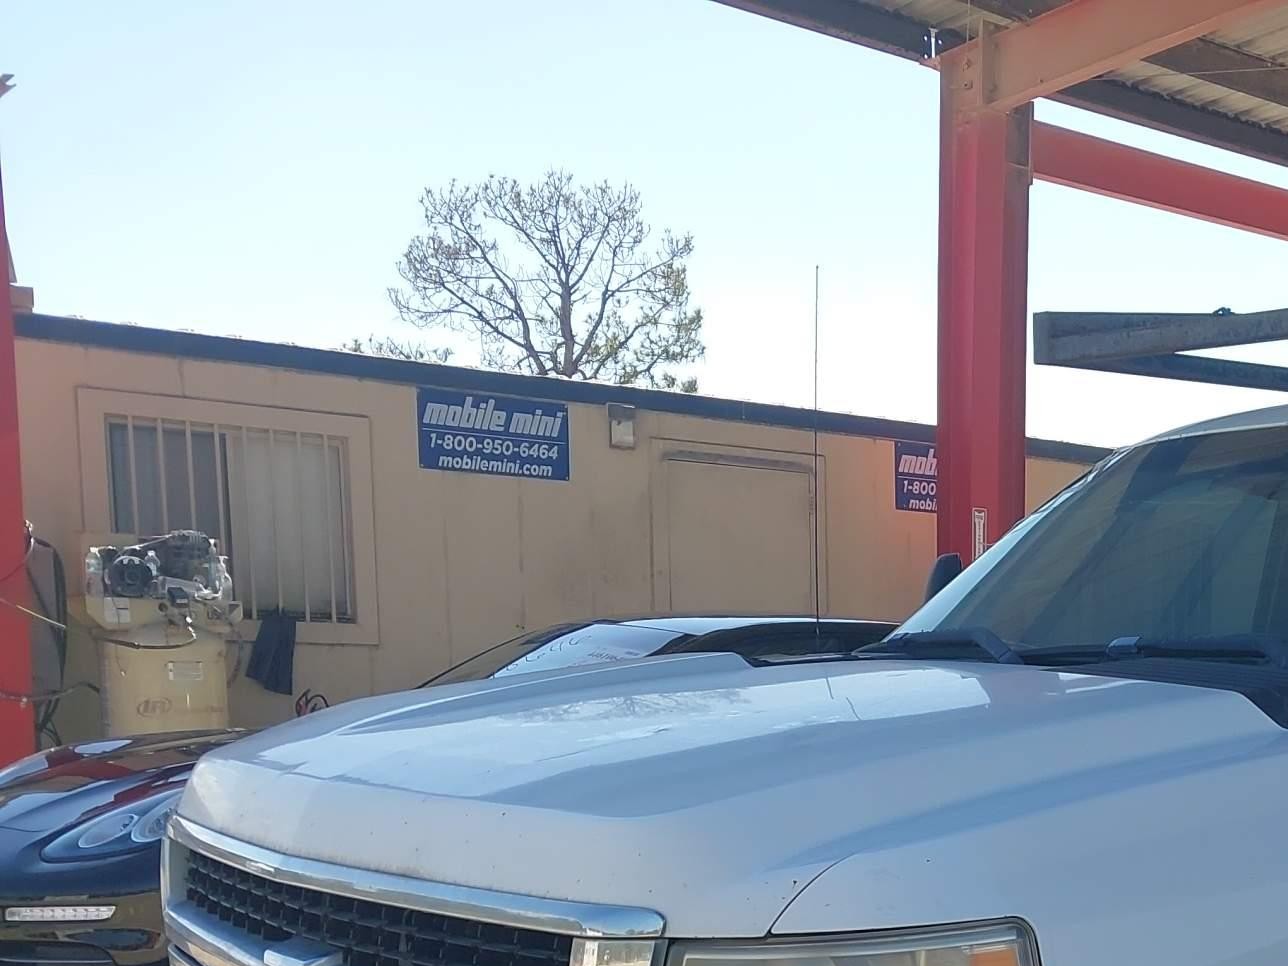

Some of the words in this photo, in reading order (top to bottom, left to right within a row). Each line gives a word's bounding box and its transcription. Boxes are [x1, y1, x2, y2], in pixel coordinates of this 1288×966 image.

[423, 396, 507, 432] mobile
[509, 409, 563, 438] mini
[429, 432, 559, 460] 1-800-950-6464
[438, 454, 553, 477] mobilemini.com
[898, 448, 938, 476] mob
[908, 497, 938, 511] mobi
